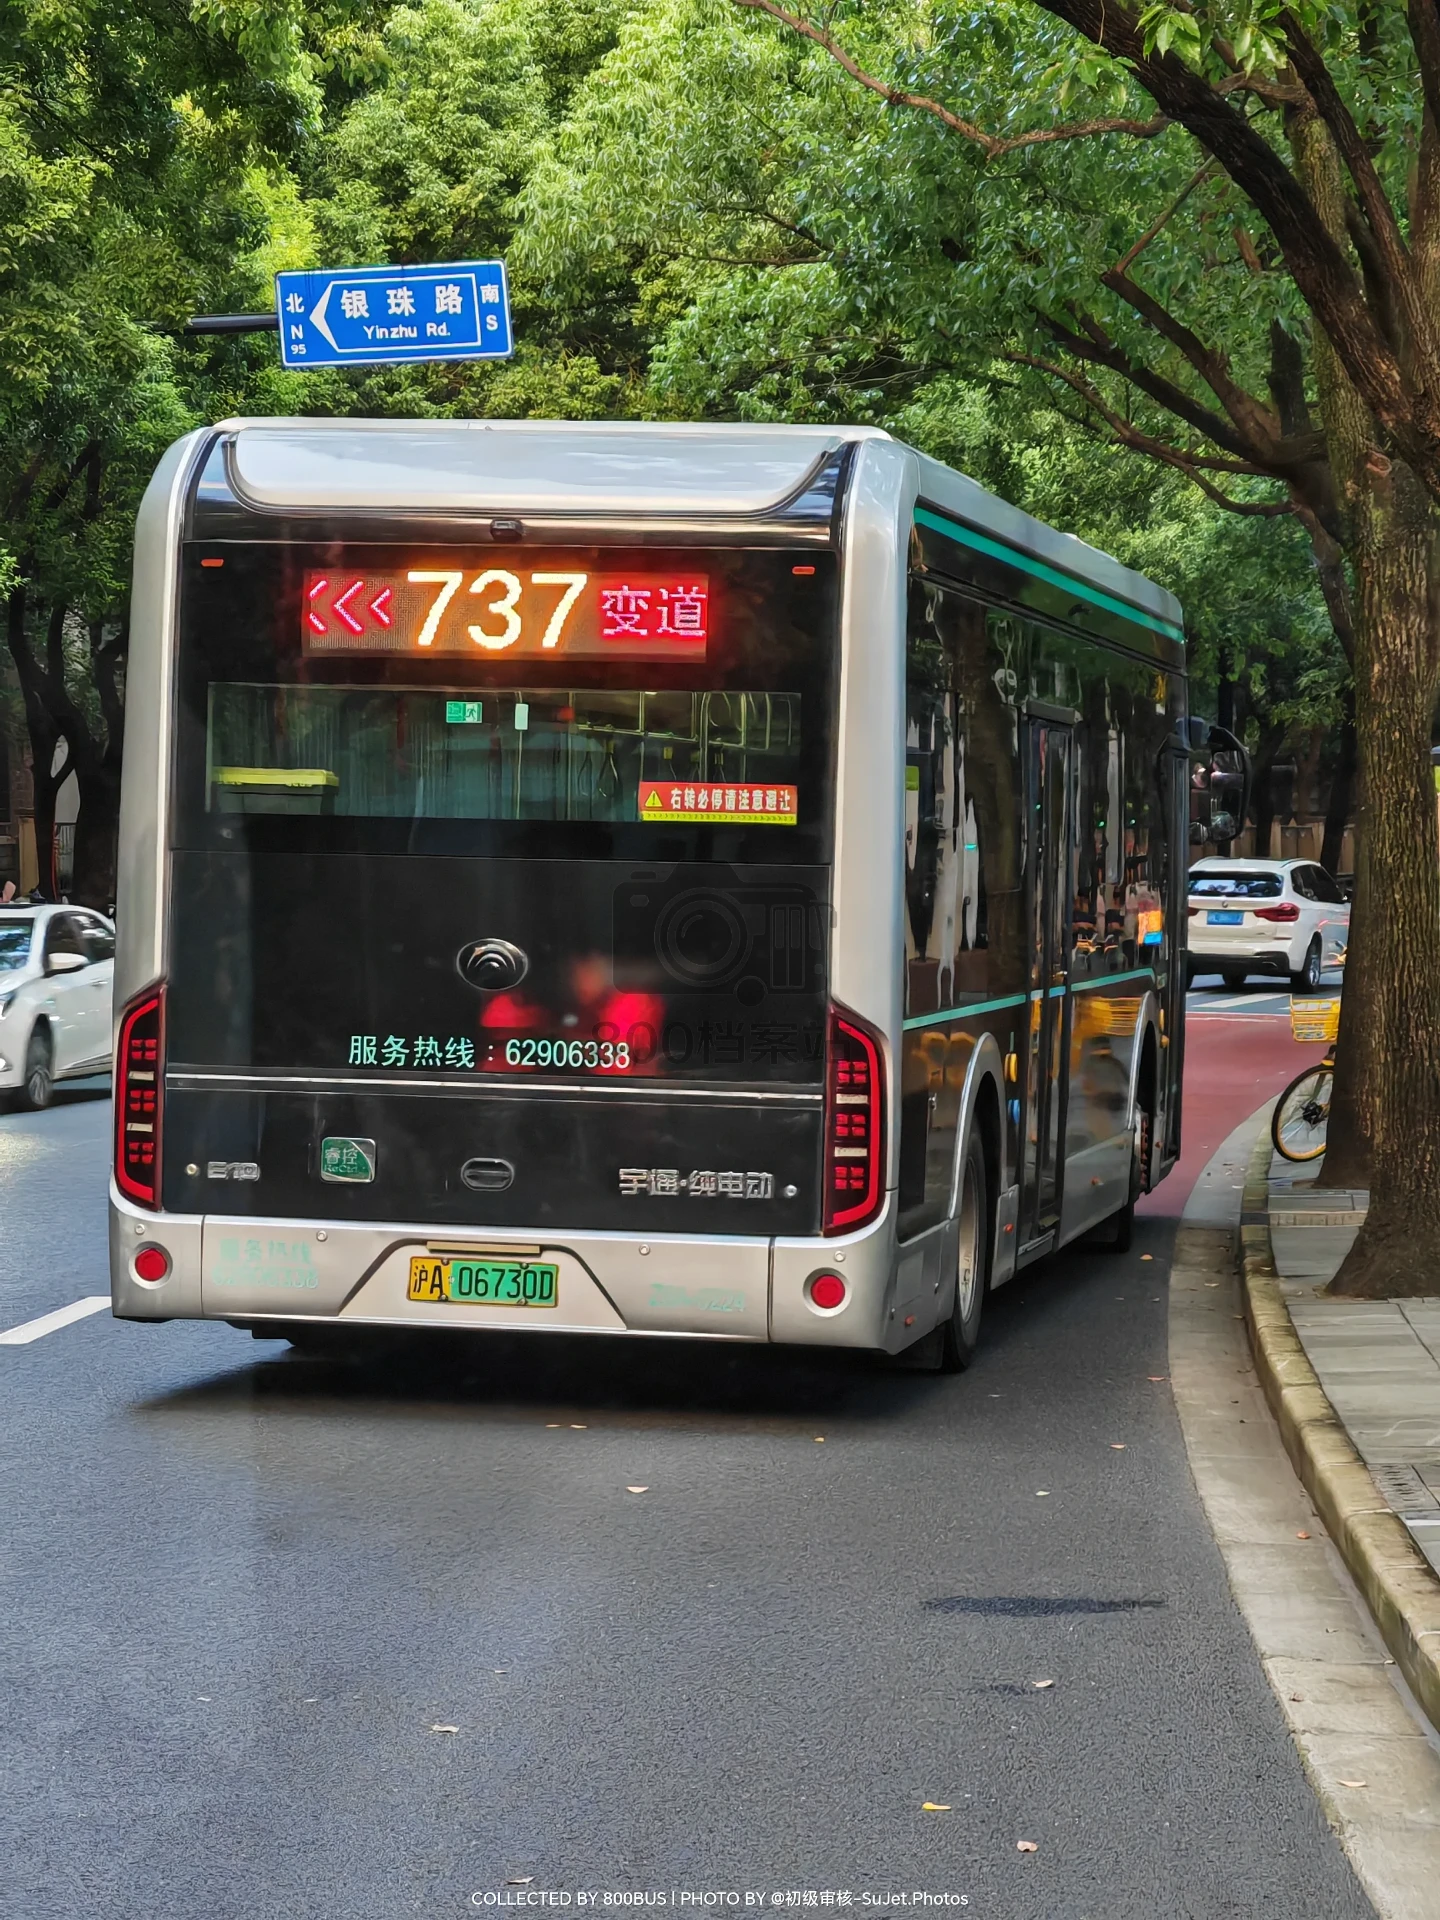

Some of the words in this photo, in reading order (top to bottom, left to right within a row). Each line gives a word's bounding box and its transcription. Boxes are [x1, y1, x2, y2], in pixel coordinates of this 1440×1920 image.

[285, 292, 305, 314] 北
[340, 283, 463, 319] 银珠路
[480, 283, 500, 304] 南
[290, 324, 304, 340] N
[363, 324, 418, 340] Yinzhu
[426, 322, 451, 337] Rd.
[485, 315, 498, 331] S
[290, 344, 306, 355] 95
[407, 569, 588, 650] 737
[602, 585, 707, 637] 变道
